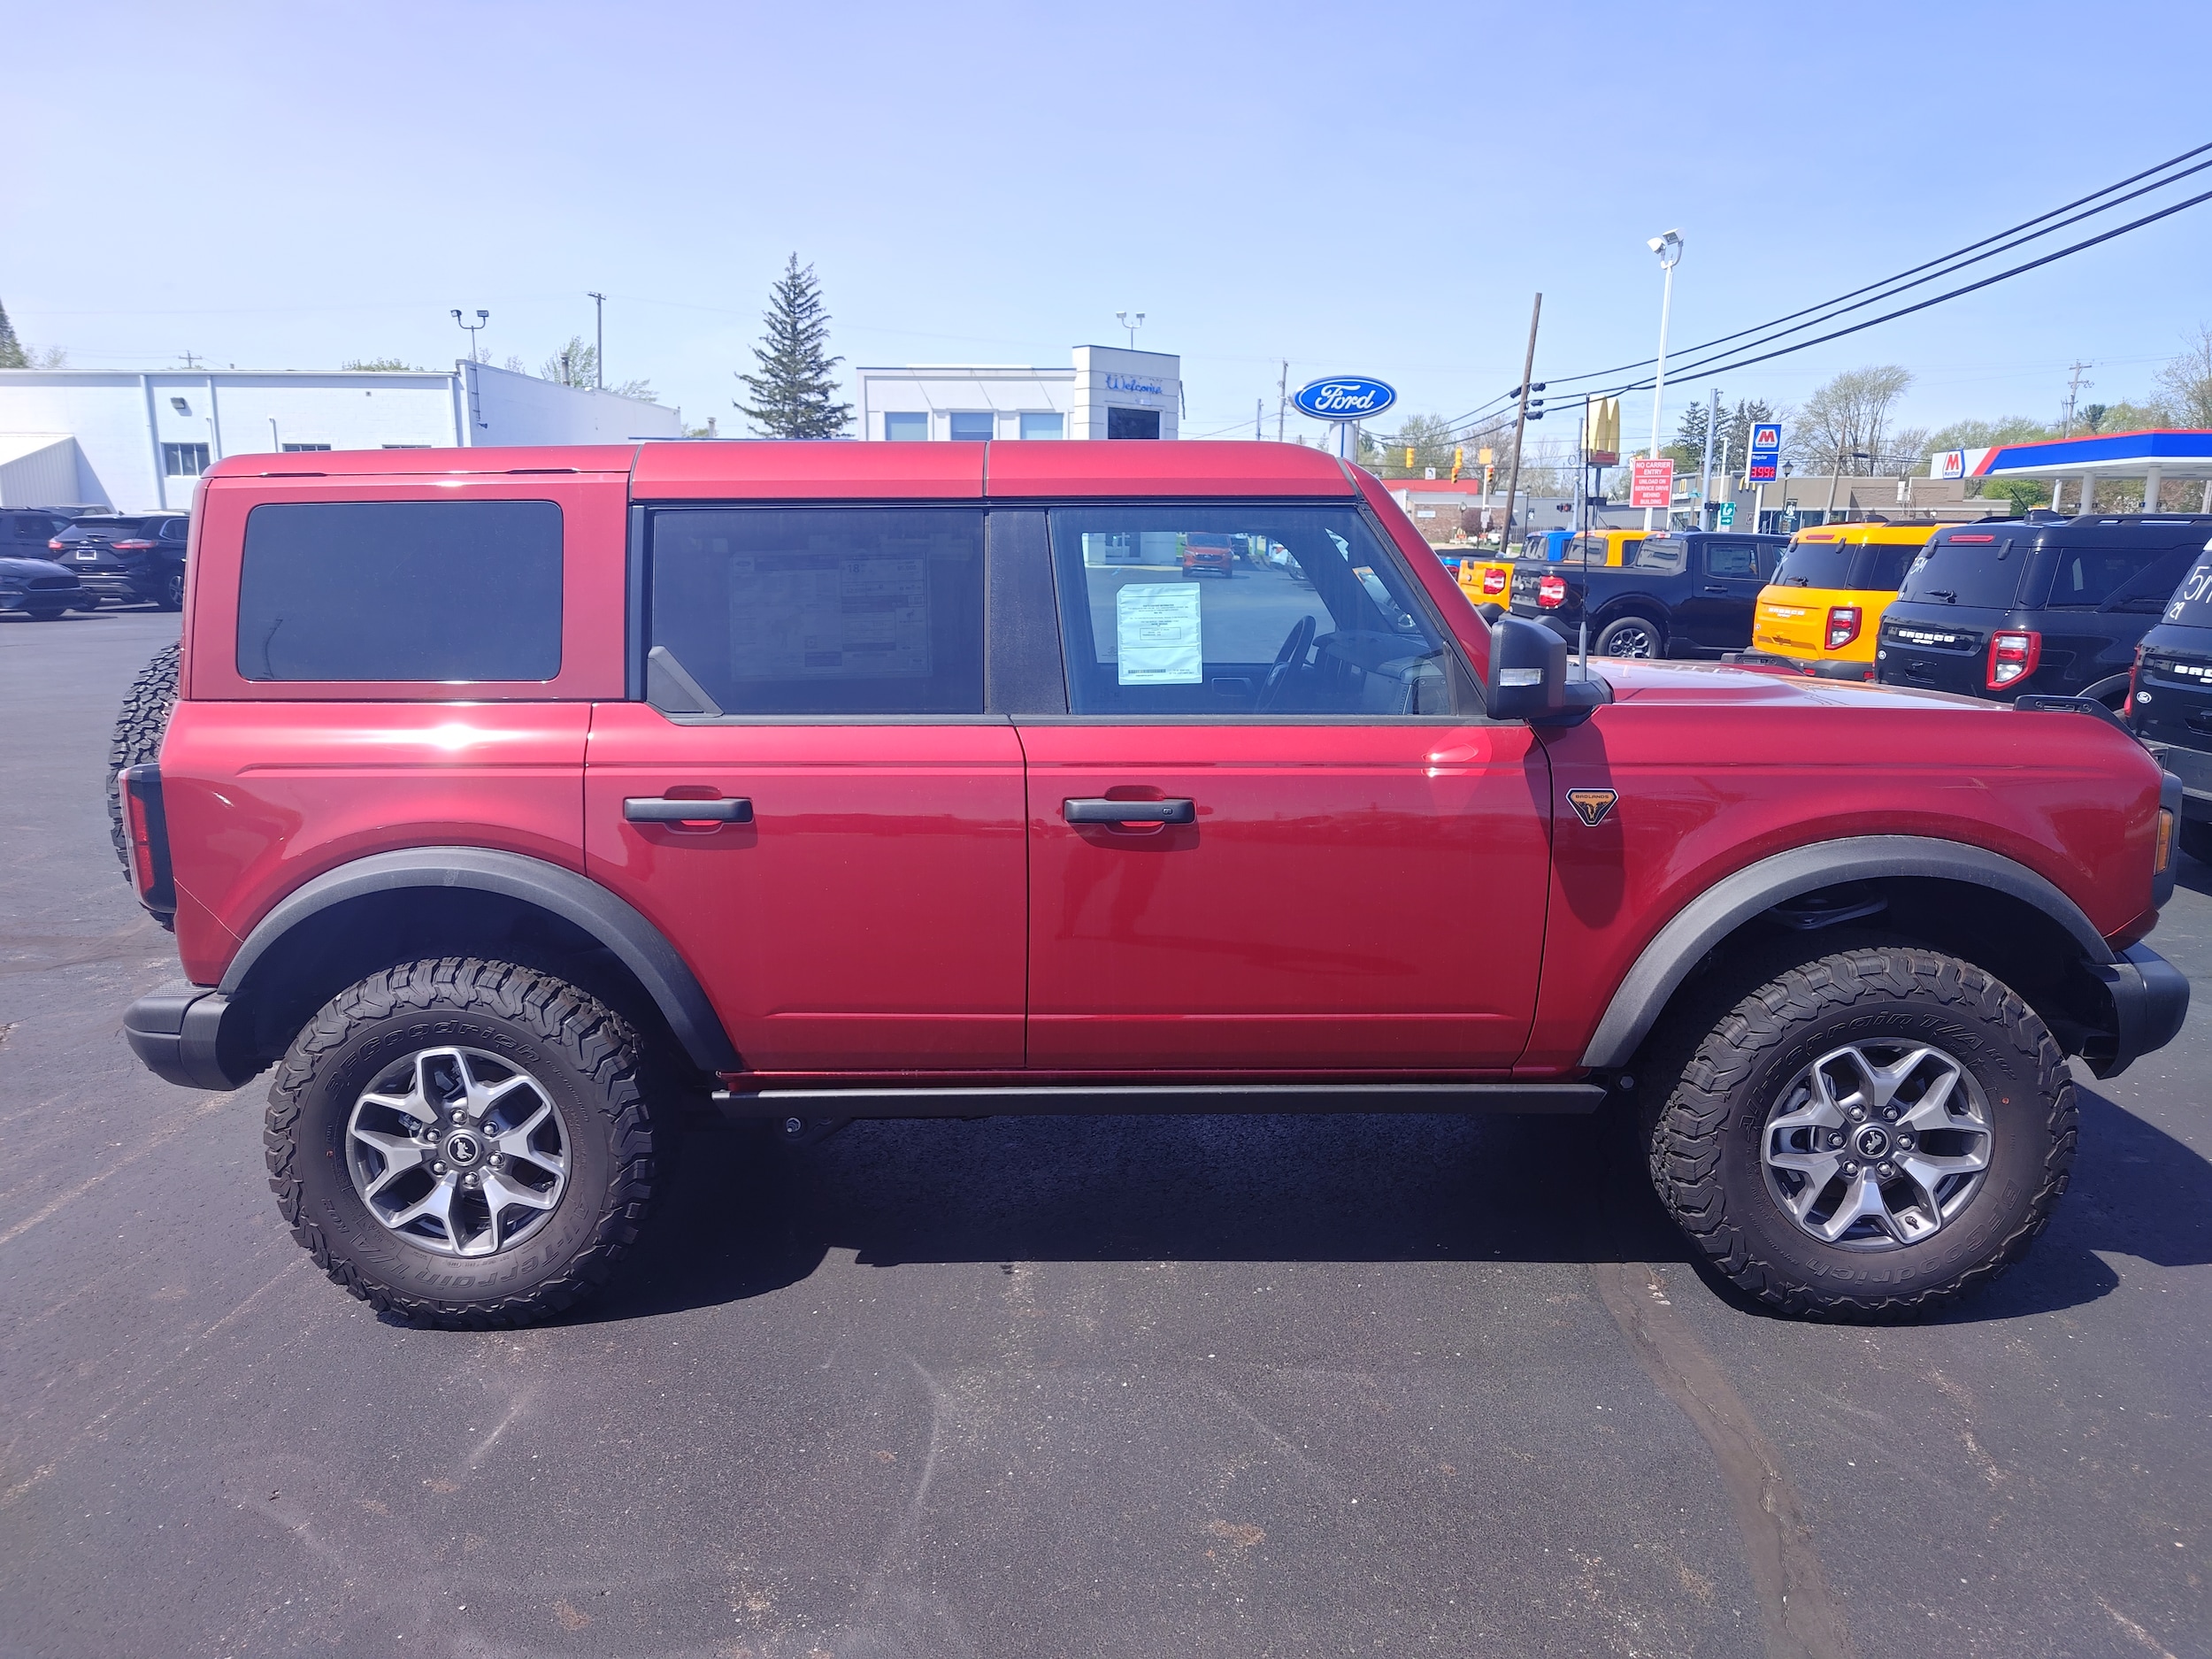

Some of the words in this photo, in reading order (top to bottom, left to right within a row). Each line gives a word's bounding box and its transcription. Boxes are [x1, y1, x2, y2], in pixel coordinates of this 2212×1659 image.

[1105, 373, 1163, 395] Welcome
[1315, 384, 1376, 411] Ford
[1898, 630, 1955, 643] BRONCO
[324, 1018, 541, 1101] BFGoodrich
[1806, 1178, 2022, 1286] BFGoodrich
